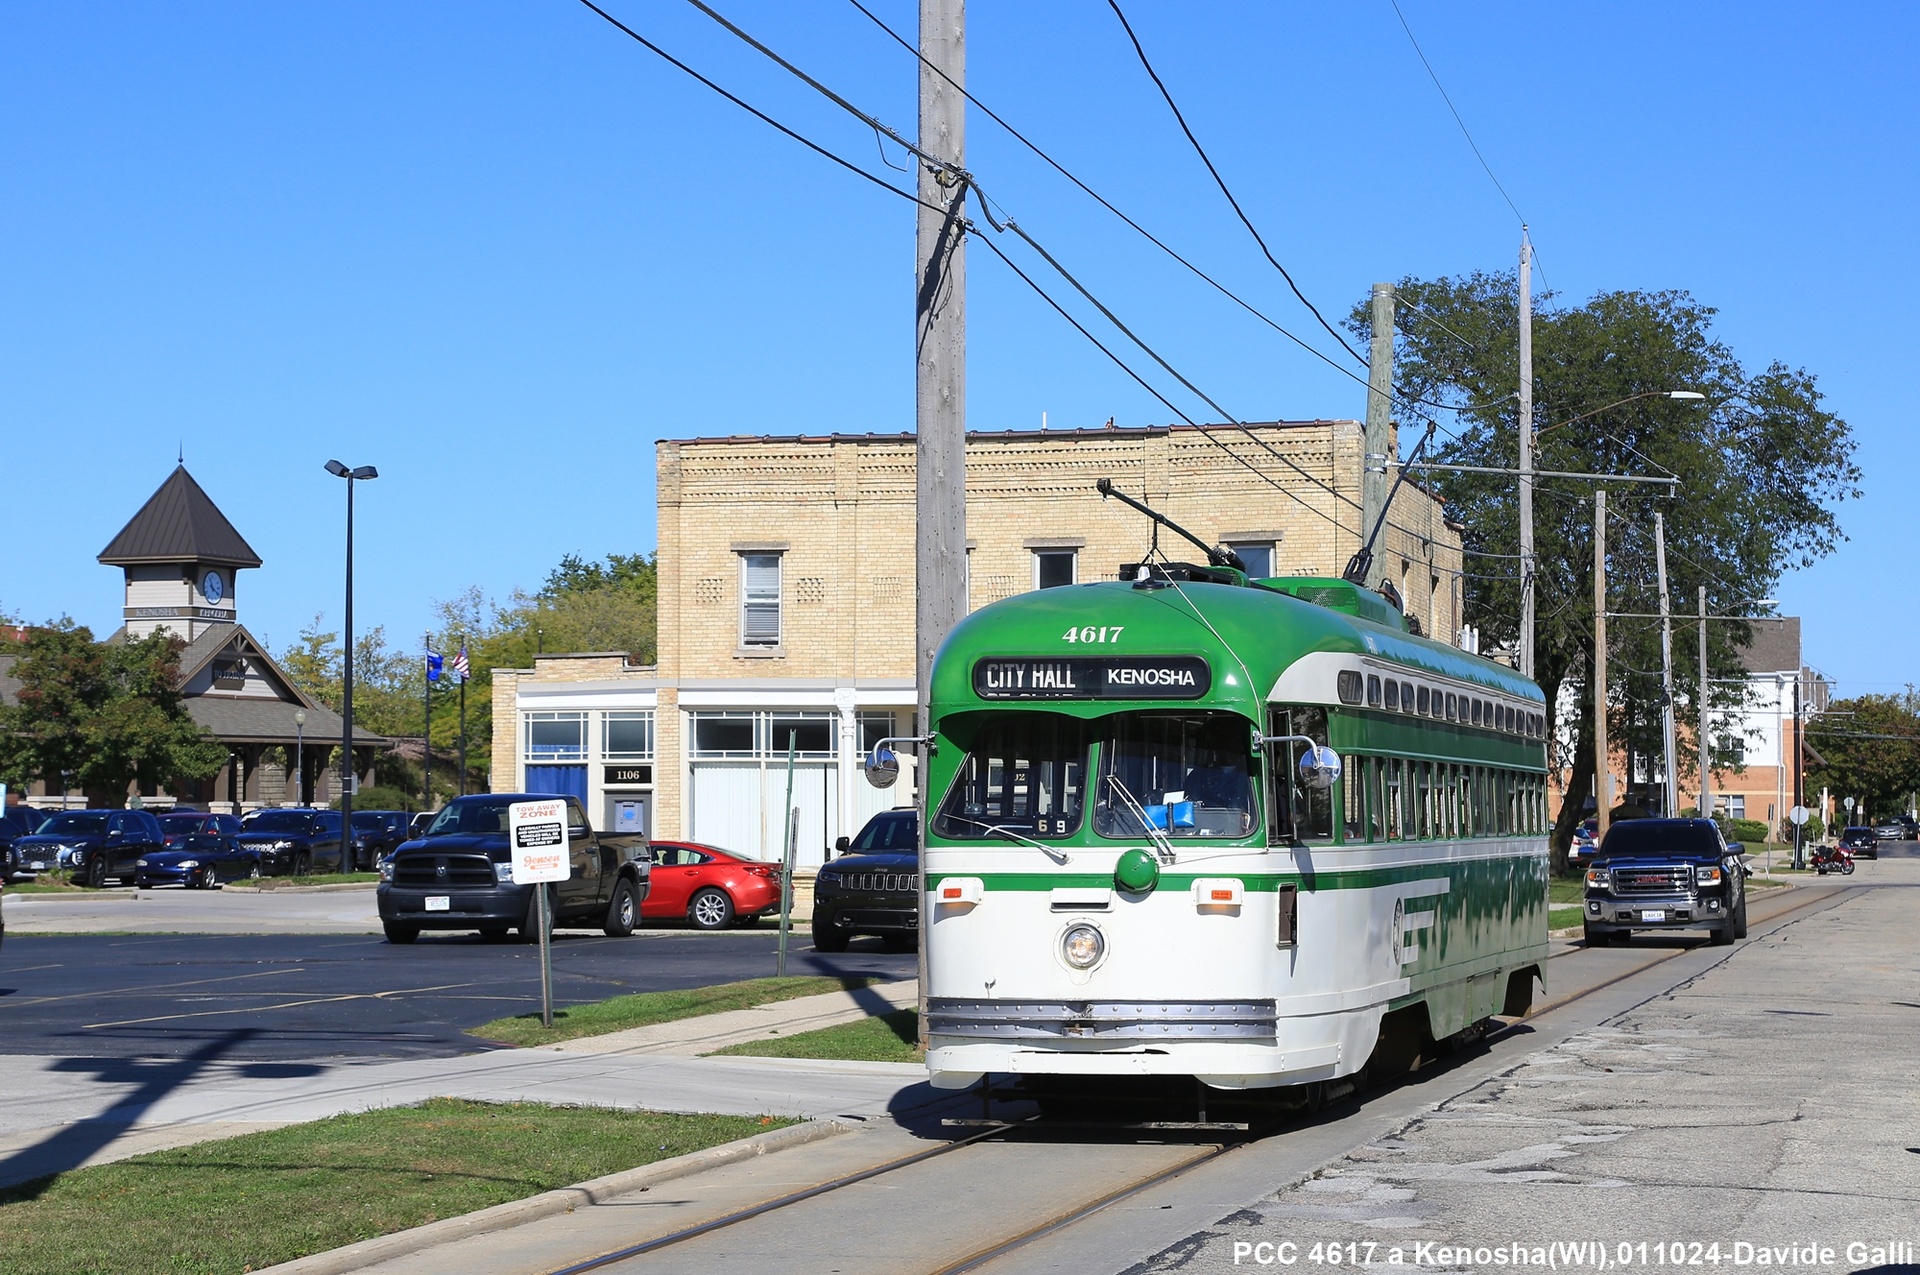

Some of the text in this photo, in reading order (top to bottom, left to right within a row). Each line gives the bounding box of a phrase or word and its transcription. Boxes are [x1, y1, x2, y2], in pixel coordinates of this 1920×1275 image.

[135, 607, 179, 617] KENOSHA
[1061, 626, 1125, 644] 4617
[986, 663, 1076, 688] CITY HALL
[1107, 668, 1195, 686] KENOSHA
[616, 770, 640, 780] 1106
[520, 810, 557, 819] ZONE
[524, 855, 560, 868] Jensen
